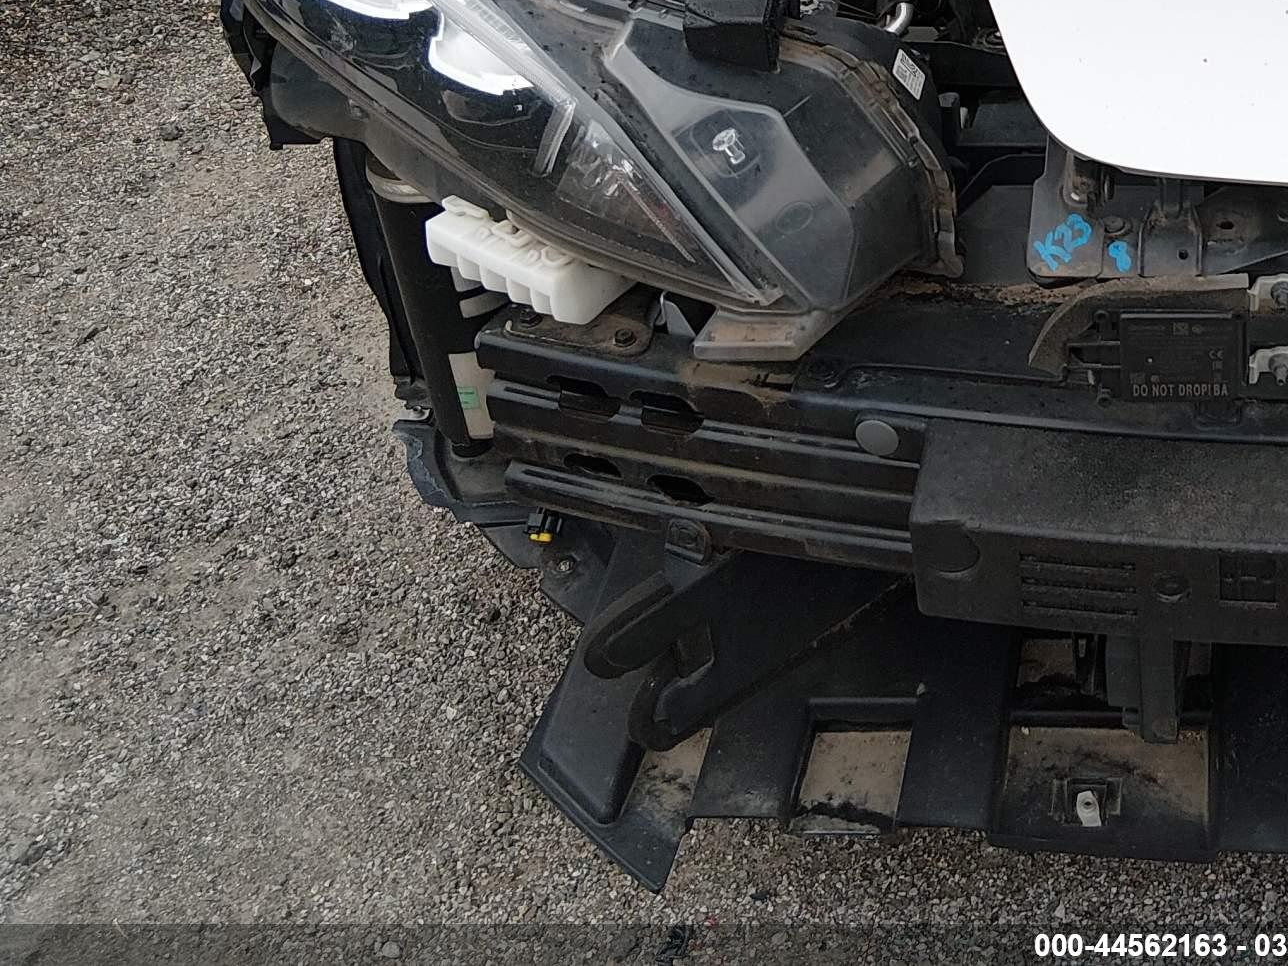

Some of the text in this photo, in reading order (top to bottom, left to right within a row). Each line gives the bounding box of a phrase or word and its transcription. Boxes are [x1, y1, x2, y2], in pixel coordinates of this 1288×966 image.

[1034, 214, 1091, 271] K23
[1132, 383, 1149, 397] DO
[1151, 383, 1176, 397] NOT
